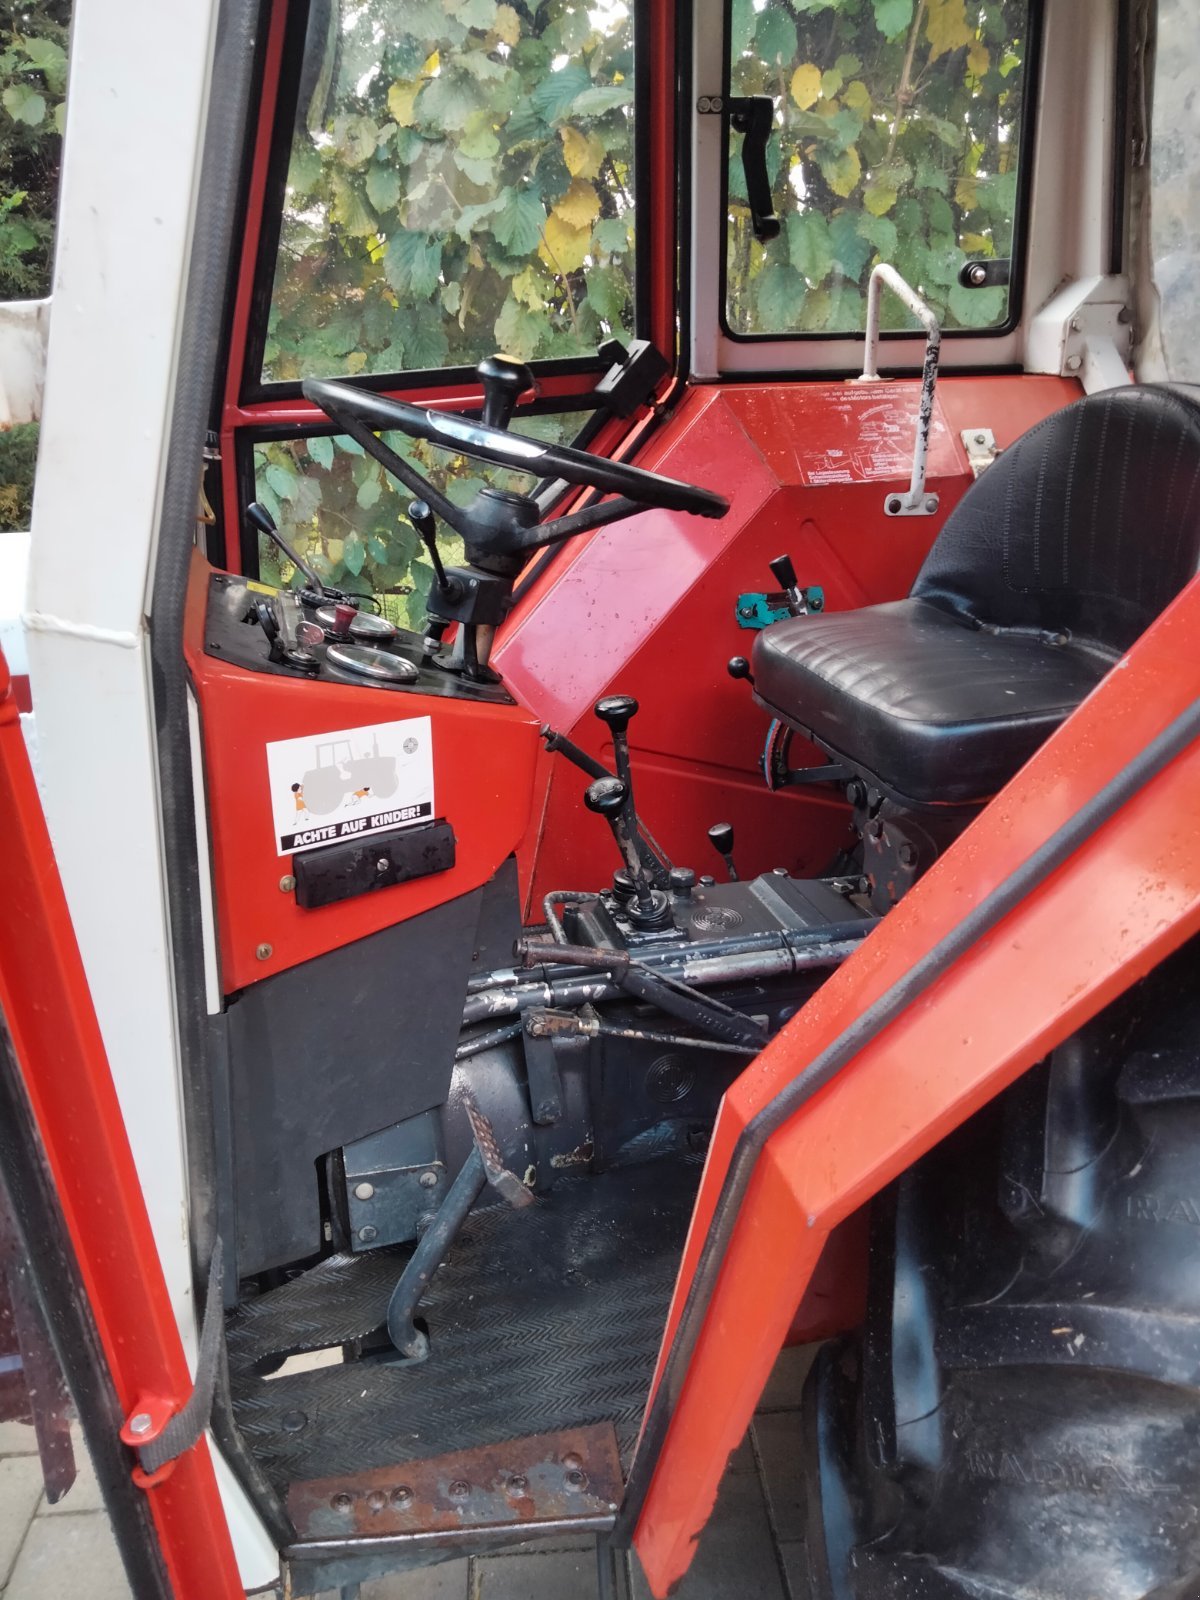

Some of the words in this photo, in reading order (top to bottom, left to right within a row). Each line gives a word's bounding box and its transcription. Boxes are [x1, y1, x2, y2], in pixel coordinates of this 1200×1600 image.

[293, 826, 336, 847] ACHTE
[340, 818, 367, 835] AUF
[370, 805, 421, 828] KINDER!
[967, 1448, 1181, 1494] RADIAL
